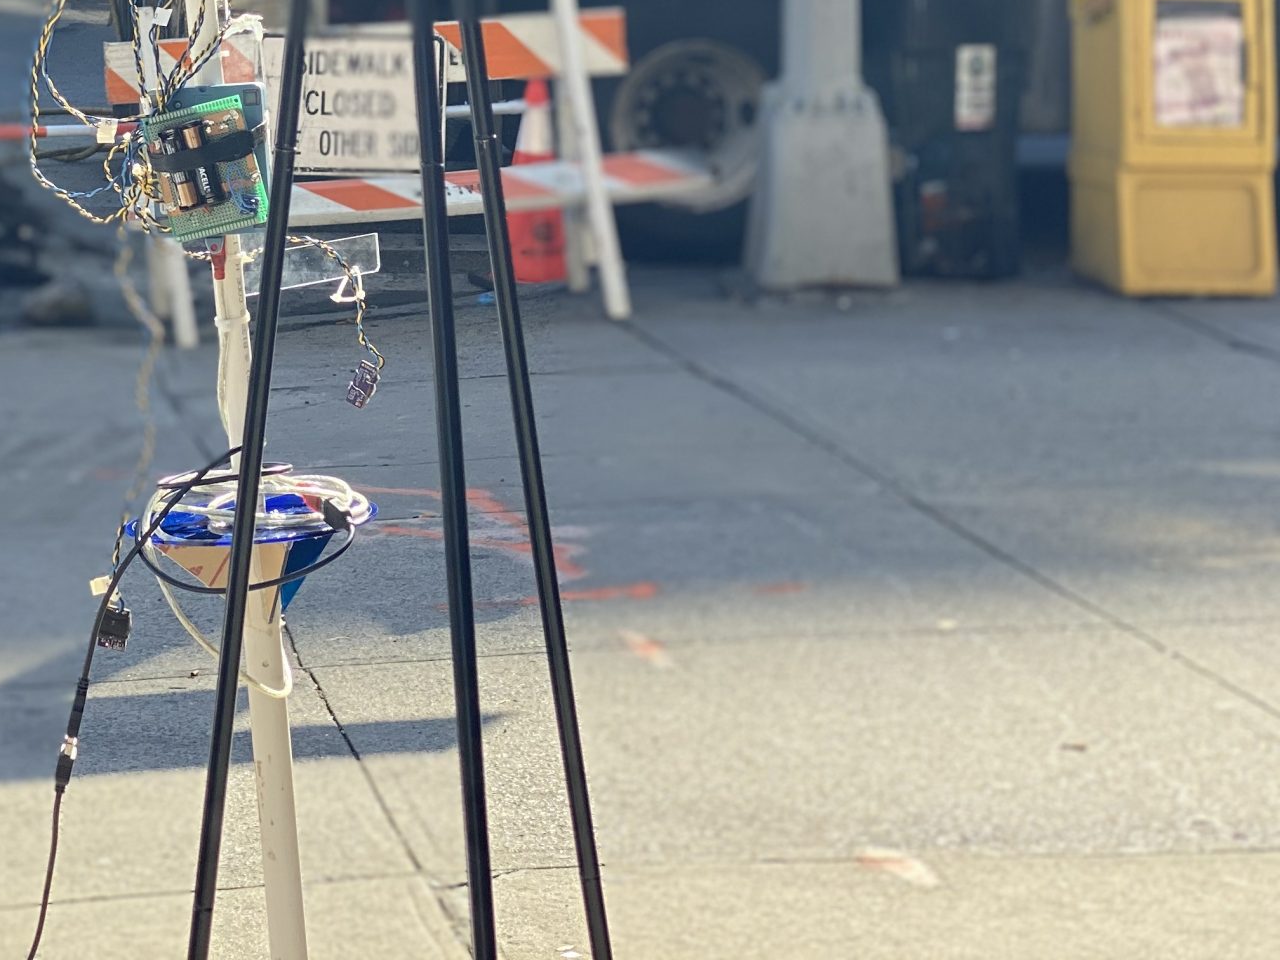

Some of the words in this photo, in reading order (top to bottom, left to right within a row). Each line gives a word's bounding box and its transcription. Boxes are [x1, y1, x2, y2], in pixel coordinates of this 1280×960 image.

[305, 90, 398, 118] CLOSED
[319, 130, 378, 158] OTHER
[389, 130, 420, 158] SID
[198, 166, 211, 193] ACELL
